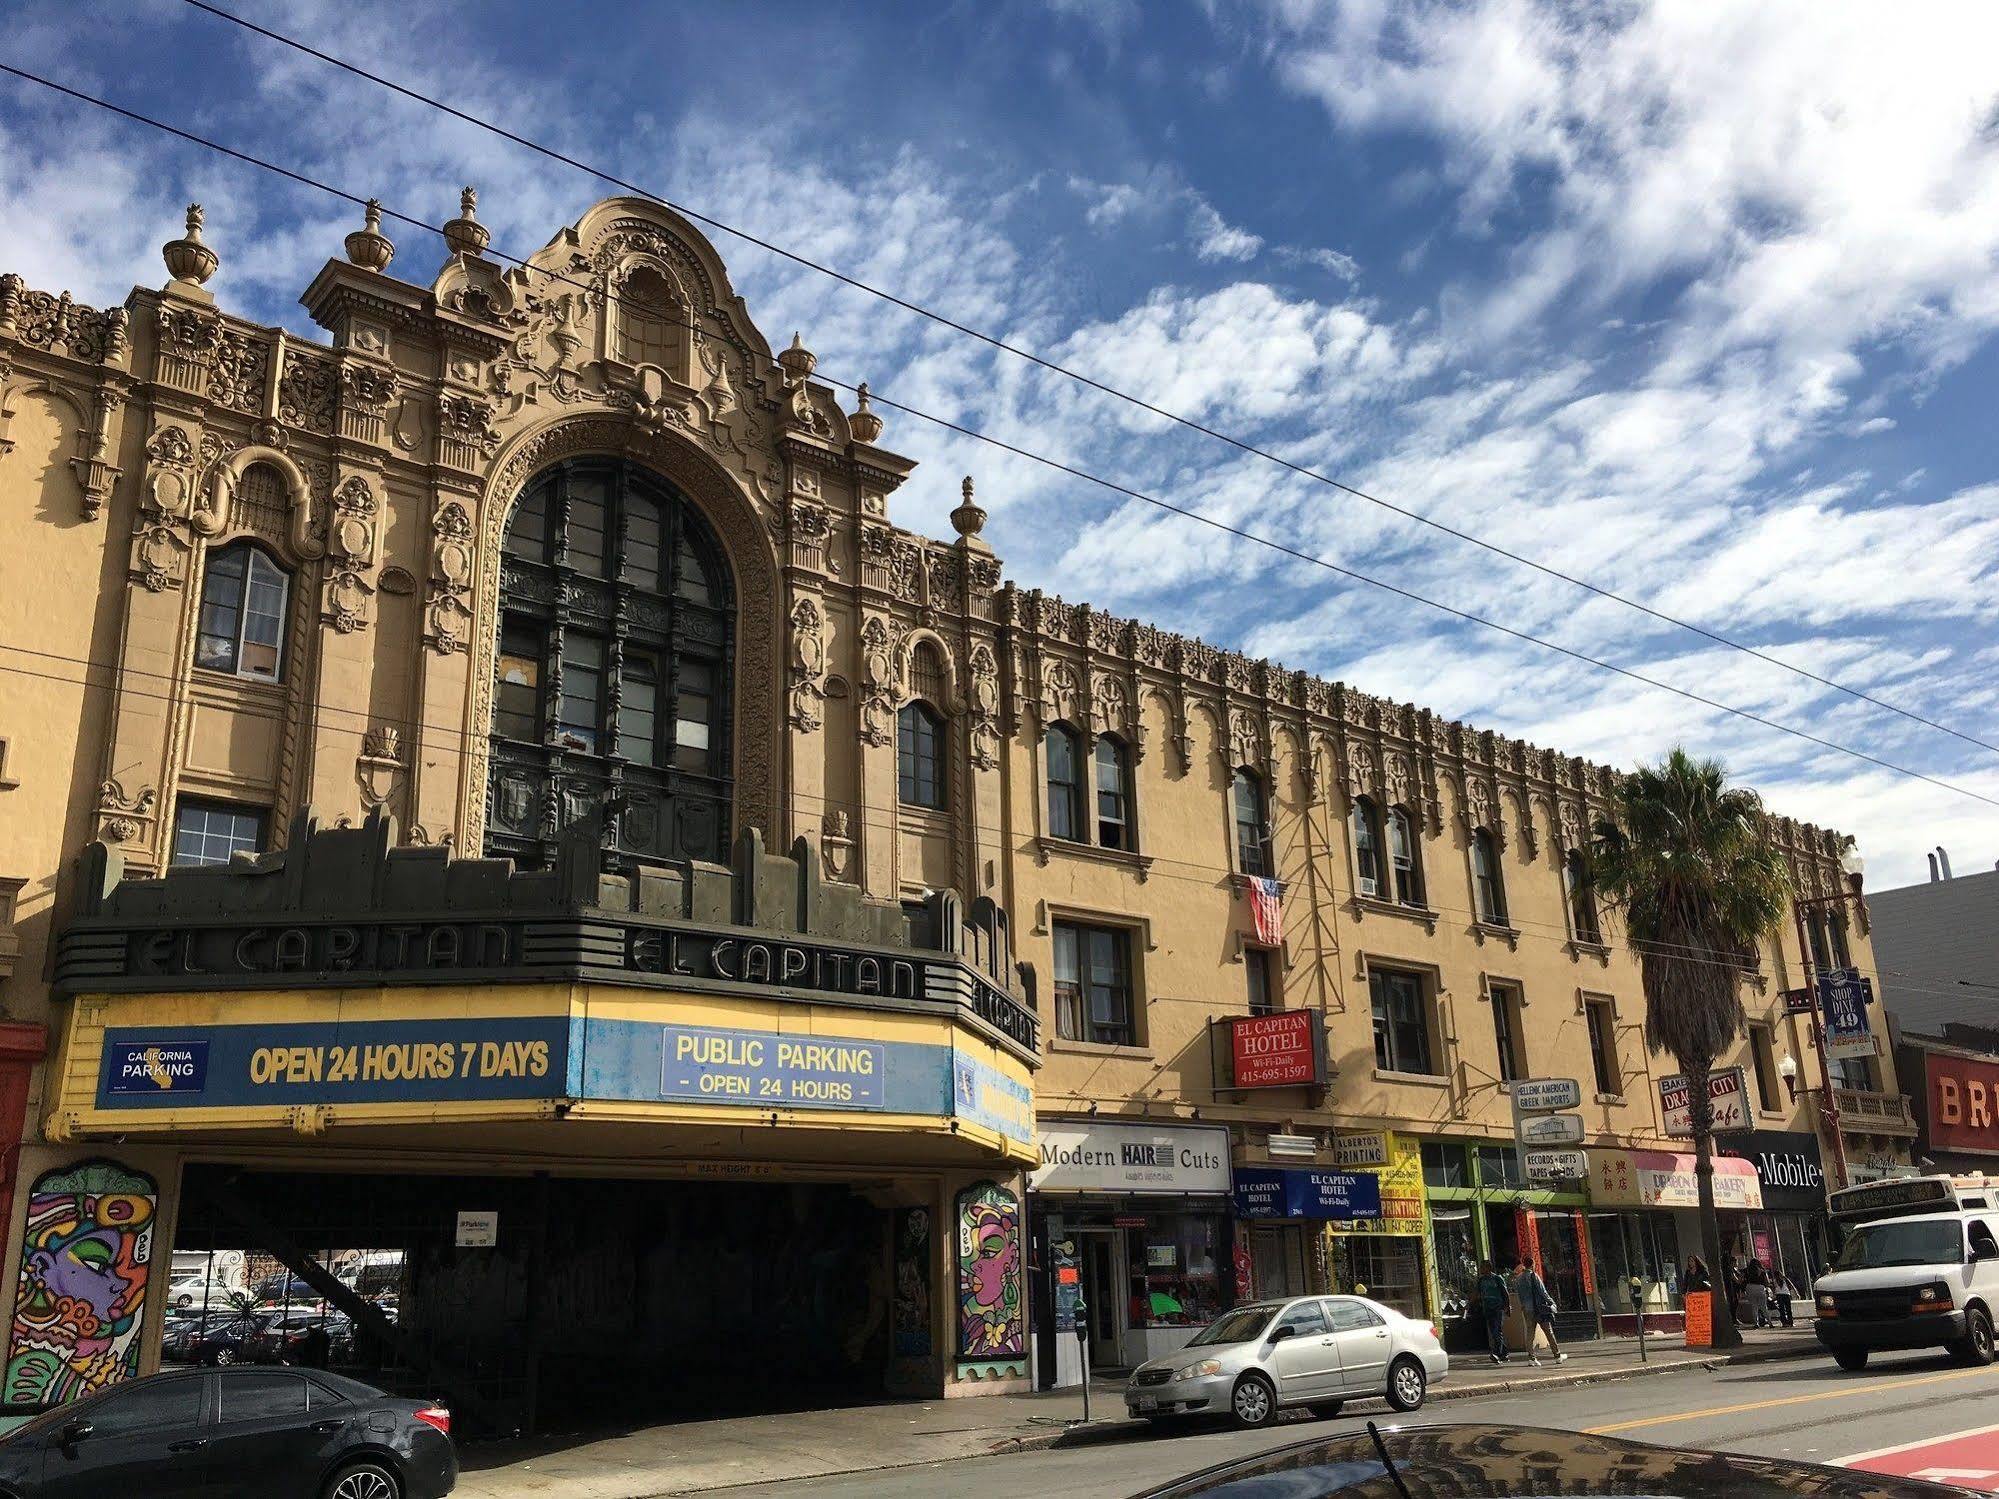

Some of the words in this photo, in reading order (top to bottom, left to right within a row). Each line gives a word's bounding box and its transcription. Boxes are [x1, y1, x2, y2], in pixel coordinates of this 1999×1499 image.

[633, 930, 695, 976] EL
[712, 938, 915, 998] CAPITAN
[1830, 987, 1852, 1000] SHOP
[1832, 999, 1856, 1014] DINE
[1236, 1023, 1252, 1036] EL
[1254, 1015, 1307, 1034] CAPITAN
[1836, 1012, 1858, 1028] 49
[1243, 1031, 1302, 1054] HOTEL
[127, 1051, 192, 1062] CALIFORNIA
[250, 1047, 324, 1084] OPEN
[327, 1046, 358, 1082] 24
[362, 1042, 455, 1081] HOURS
[461, 1042, 477, 1078] 7
[480, 1040, 549, 1078] DAYS
[676, 1035, 764, 1068] PUBLIC
[777, 1042, 874, 1075] PARKING
[1252, 1056, 1294, 1067] Wi-Fi-Daily
[122, 1063, 194, 1077] PARKING
[1241, 1065, 1307, 1082] 415-695-1597
[699, 1075, 750, 1095] OPEN
[760, 1077, 782, 1097] 24
[791, 1080, 852, 1101] HOURS
[1541, 1083, 1570, 1093] AMERICAN
[1712, 1076, 1736, 1095] CITY
[1520, 1097, 1540, 1107] GREEK
[1542, 1095, 1570, 1105] IMPORTS
[1338, 1136, 1378, 1148] ALBERTO'S
[1040, 1143, 1116, 1166] Modern
[1121, 1145, 1156, 1165] HAIR
[1180, 1149, 1220, 1169] Cuts
[1337, 1149, 1380, 1163] PRINTING
[1527, 1154, 1554, 1165] RECORDS
[1559, 1154, 1577, 1164] GIFTS
[1529, 1168, 1548, 1178] TAPES
[1760, 1152, 1819, 1187] Mobile
[1311, 1174, 1322, 1184] EL
[1322, 1174, 1357, 1185] CAPITAN
[1249, 1183, 1281, 1192] CAPITAN
[1320, 1185, 1348, 1195] HOTEL
[1248, 1194, 1272, 1203] HOTEL
[1381, 1200, 1421, 1216] PRINTING
